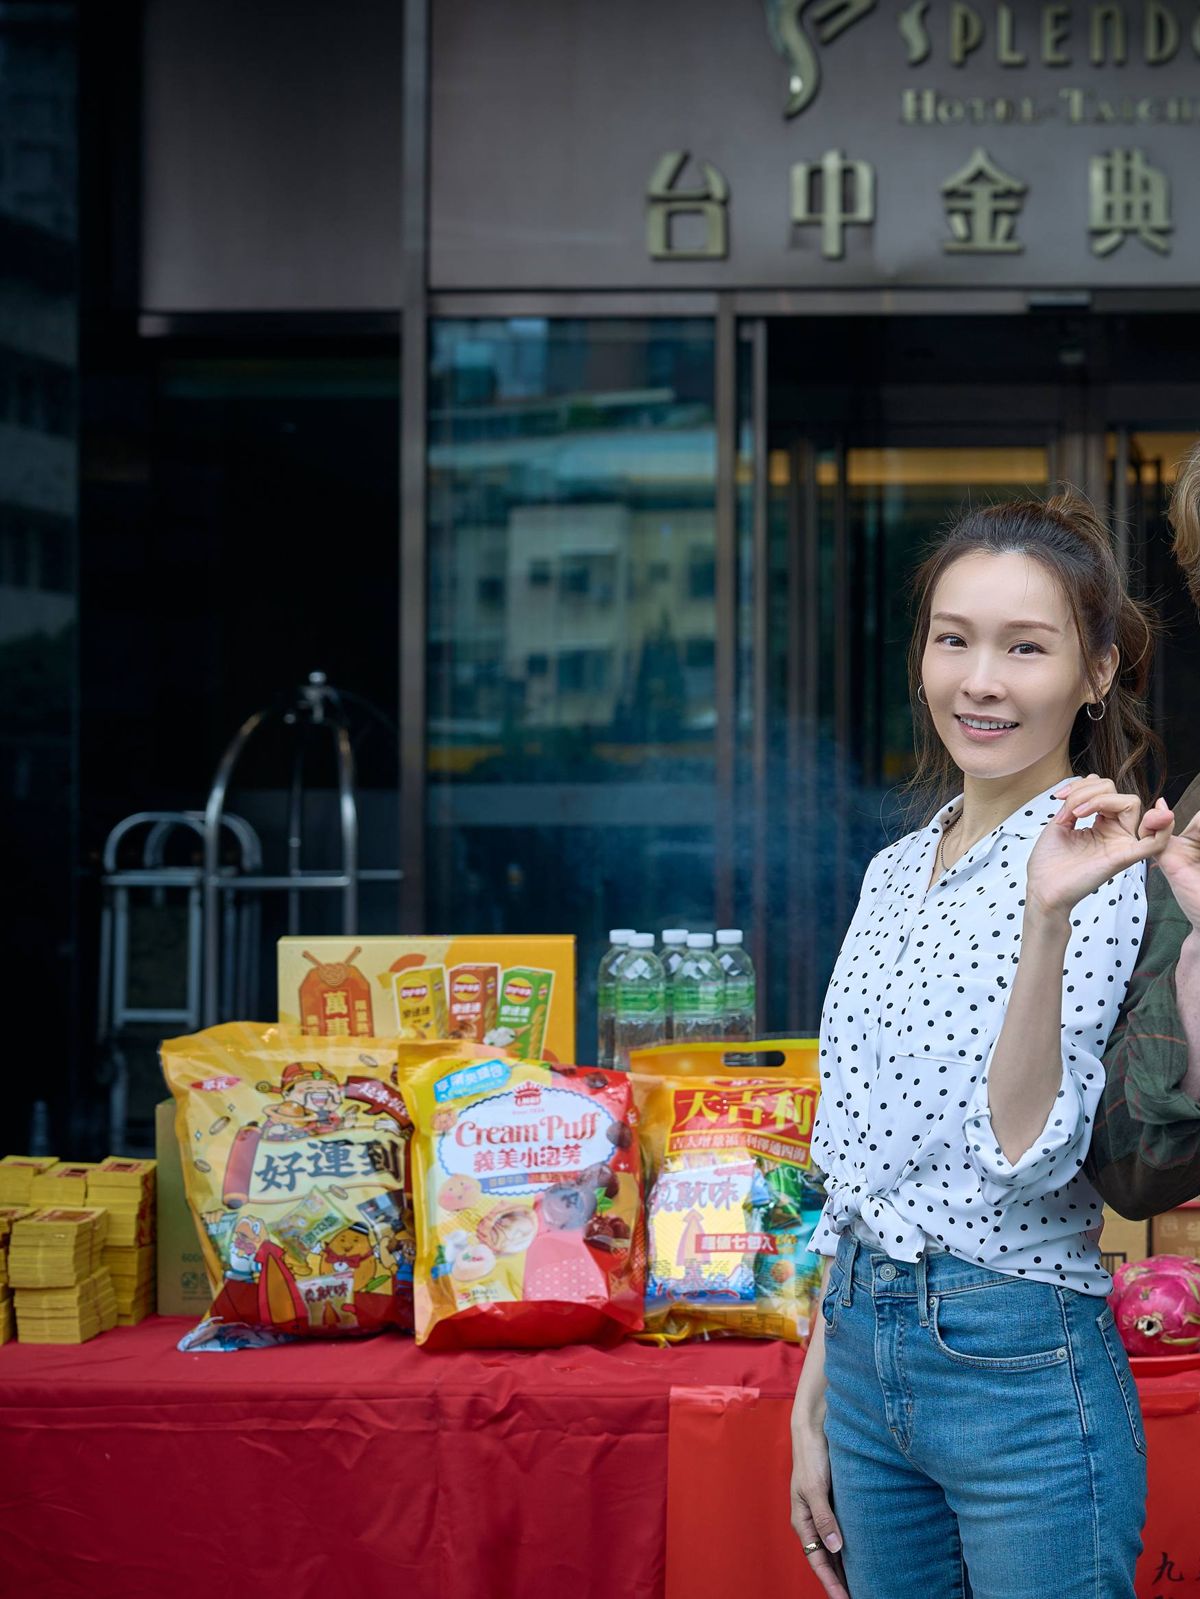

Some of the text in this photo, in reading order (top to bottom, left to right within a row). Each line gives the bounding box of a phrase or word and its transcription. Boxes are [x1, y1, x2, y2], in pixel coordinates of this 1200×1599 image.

[455, 1112, 600, 1148] Cream Puff
[677, 1088, 814, 1135] 大吉利
[254, 1136, 401, 1193] 好運到
[473, 1143, 582, 1173] 義美小泡芙
